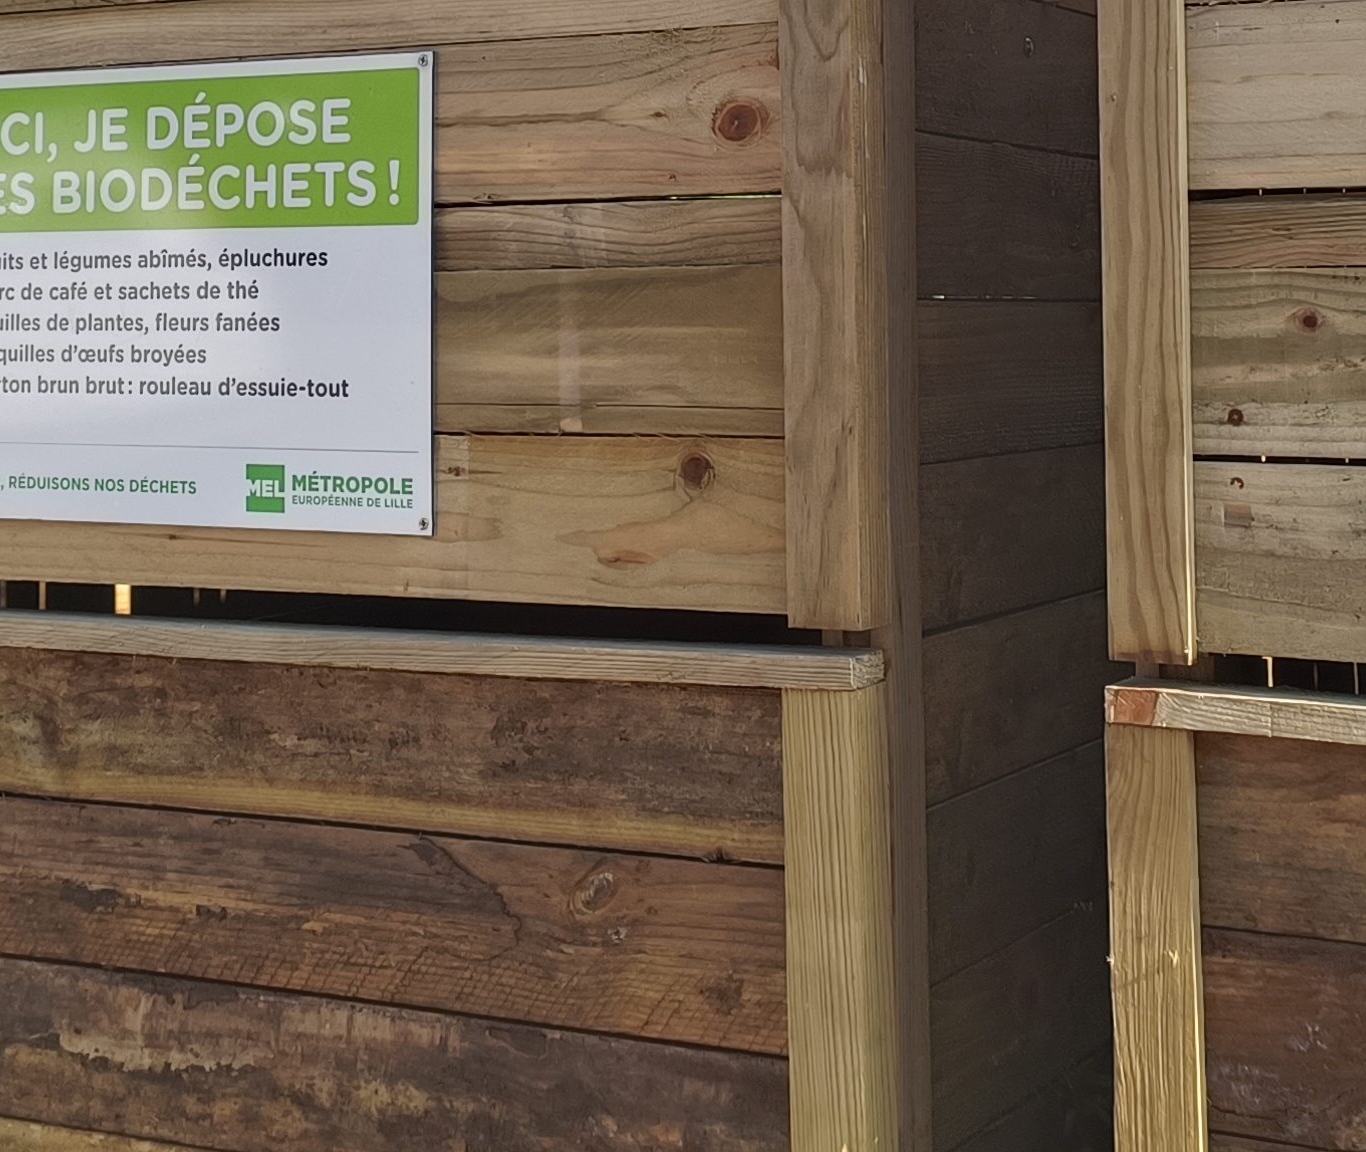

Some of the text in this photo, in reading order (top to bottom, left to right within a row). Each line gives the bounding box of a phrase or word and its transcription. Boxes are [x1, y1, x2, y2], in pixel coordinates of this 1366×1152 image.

[72, 106, 129, 152] JE
[144, 91, 351, 151] DÉPOSE
[29, 253, 47, 269] et
[54, 250, 131, 272] légumes
[137, 248, 211, 271] abîmés,
[218, 247, 328, 271] épluchures
[20, 282, 43, 300] de
[49, 281, 87, 300] café
[93, 283, 112, 300] et
[118, 281, 189, 300] sachets
[196, 280, 220, 299] de
[226, 279, 259, 299] thé
[46, 313, 69, 331] de
[75, 313, 148, 335] plantes,
[155, 312, 209, 331] fleurs
[215, 312, 280, 331] fanées
[61, 343, 124, 363] d’œufs
[130, 343, 206, 367] broyées
[37, 375, 79, 393] brun
[139, 376, 211, 395] rouleau
[218, 376, 349, 397] d’essuie-tout
[8, 472, 89, 491] RÉDUISONS
[94, 478, 124, 492] NOS
[129, 476, 196, 494] DÉCHETS
[292, 470, 413, 495] MÉTROPOLE
[291, 493, 413, 509] EUROPÉENNE DE LILLE
